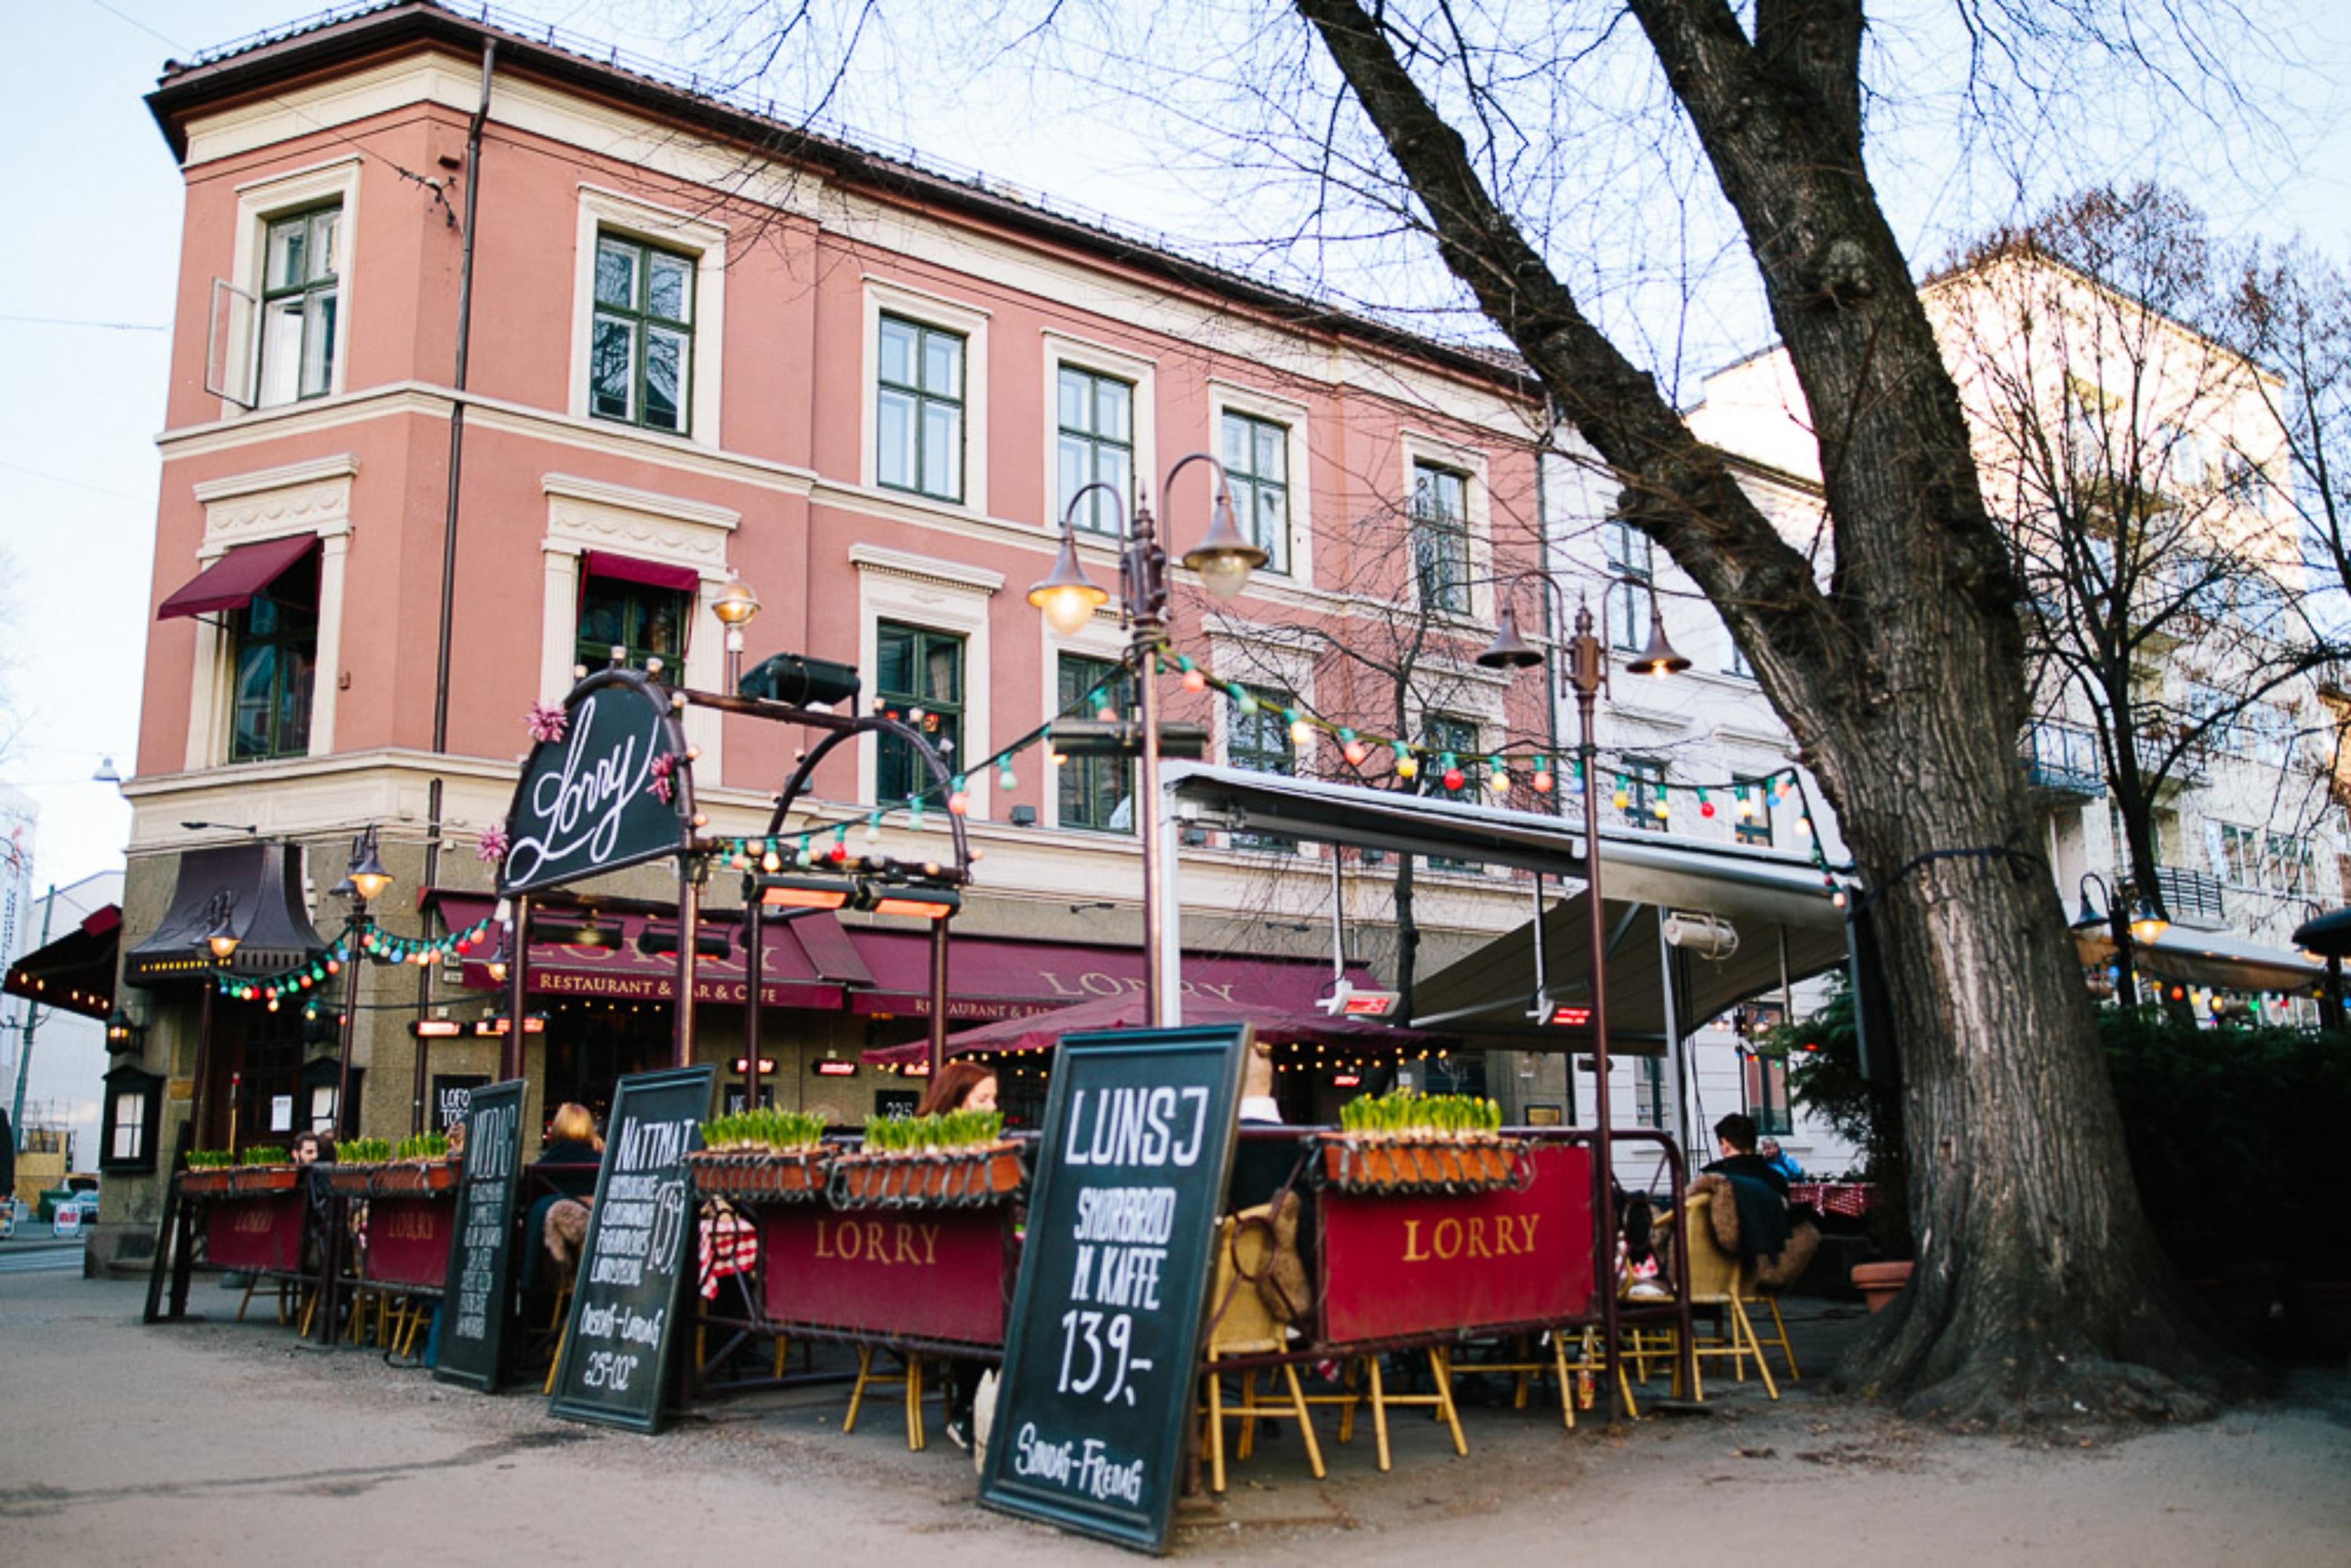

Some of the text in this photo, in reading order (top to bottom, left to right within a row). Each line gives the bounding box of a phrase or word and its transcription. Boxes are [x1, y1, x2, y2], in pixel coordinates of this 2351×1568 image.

[506, 696, 659, 885] Lorry
[540, 973, 652, 994] RESTAURANT
[658, 980, 672, 996] &
[735, 985, 777, 1002] CFE
[1065, 1086, 1210, 1167] LUNSJ
[815, 1220, 940, 1265] LORRY
[1074, 1187, 1176, 1244] SMØRBRØD
[1402, 1214, 1540, 1262] LORRY
[1096, 1245, 1167, 1310] KAFFE
[1057, 1309, 1153, 1406] 139,-
